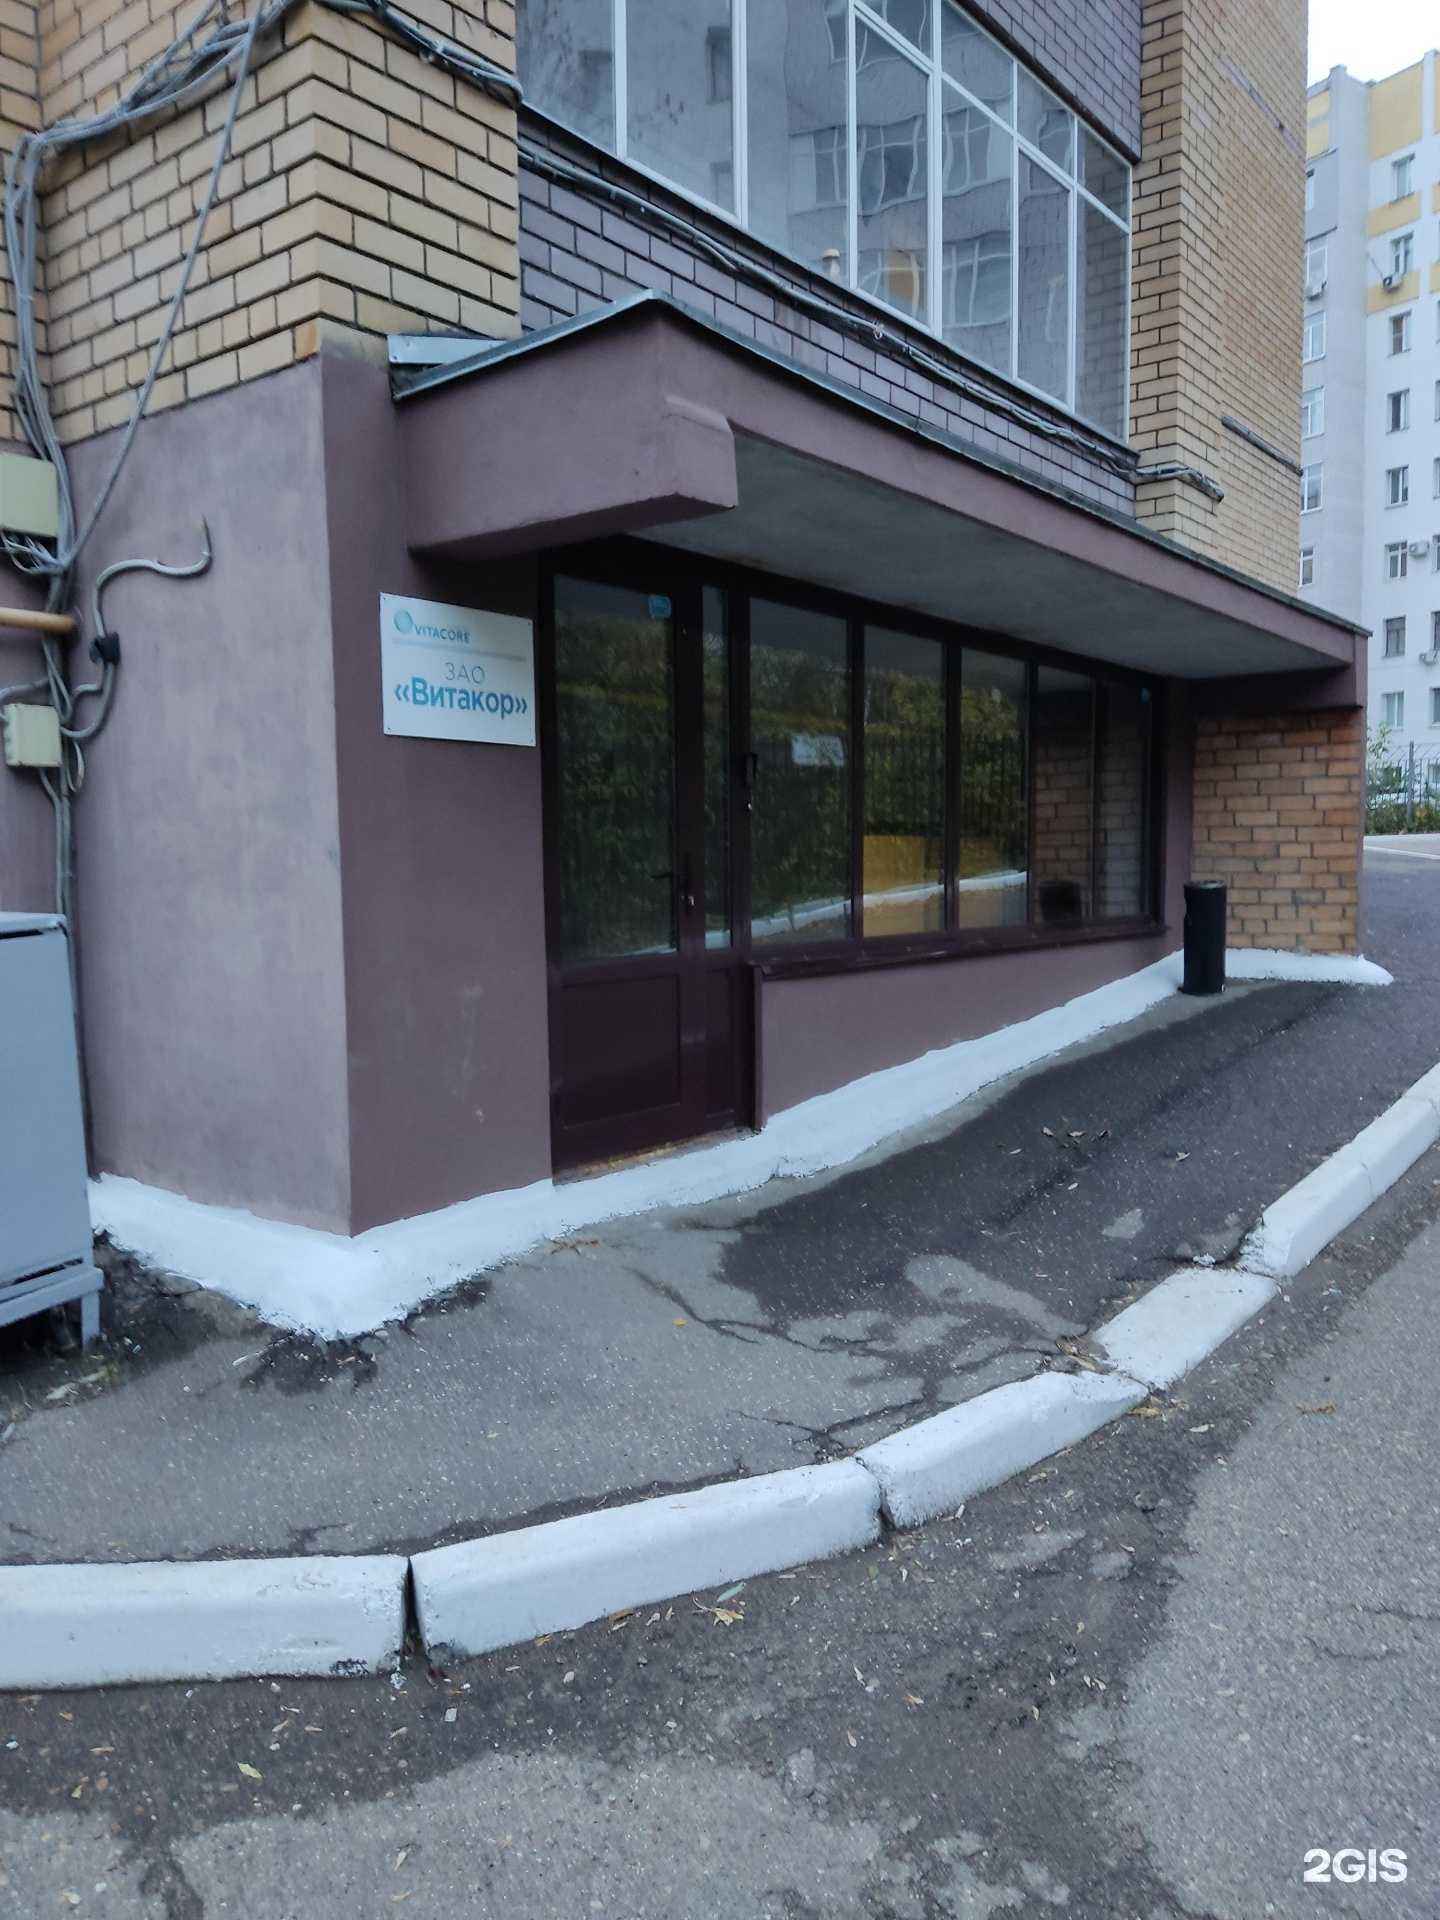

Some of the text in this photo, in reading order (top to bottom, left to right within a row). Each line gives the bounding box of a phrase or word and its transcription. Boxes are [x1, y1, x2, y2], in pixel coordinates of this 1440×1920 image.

[415, 624, 470, 643] VITACORE
[445, 662, 485, 684] ЗАО
[394, 677, 528, 719] «Витакор»
